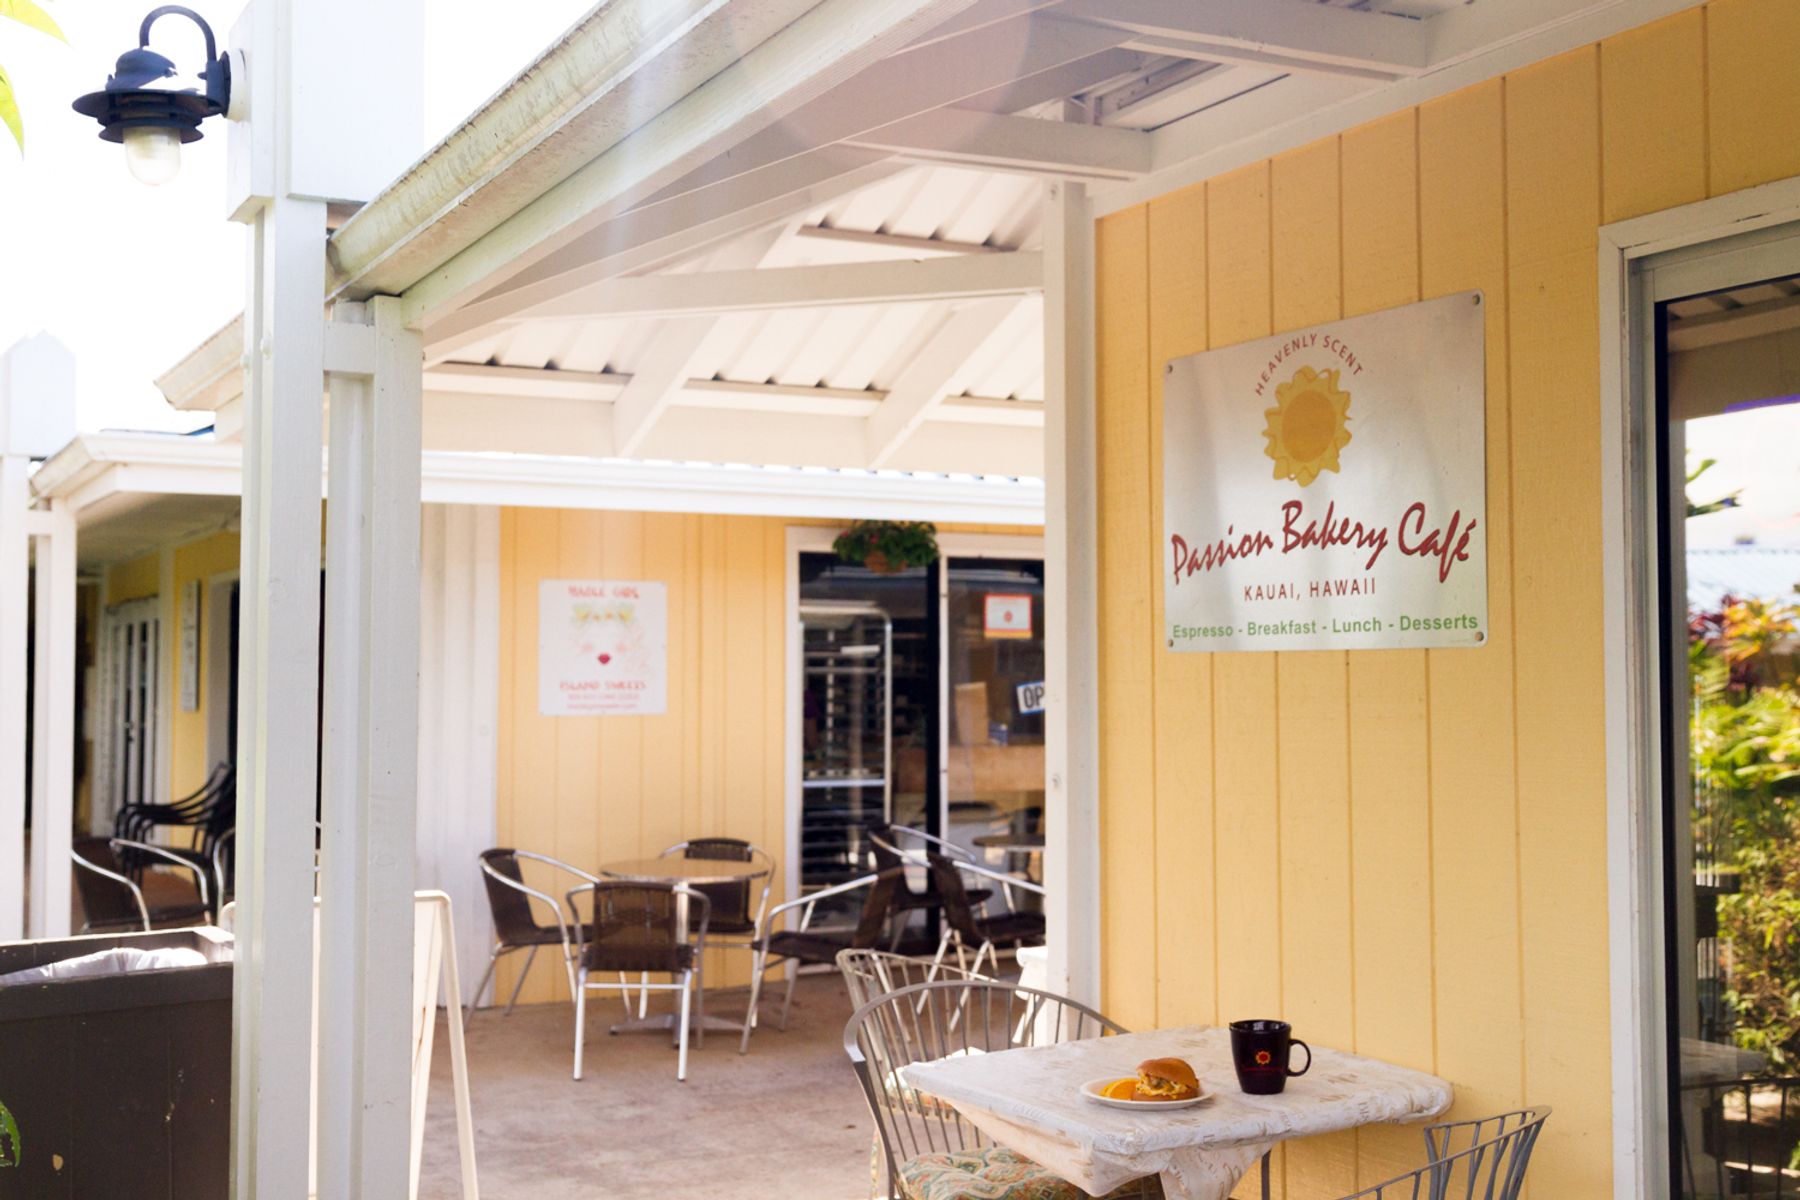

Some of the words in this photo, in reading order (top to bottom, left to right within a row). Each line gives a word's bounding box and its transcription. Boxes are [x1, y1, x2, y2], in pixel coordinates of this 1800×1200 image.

[1255, 333, 1317, 396] HEAVENLY
[1323, 335, 1363, 376] SCENT
[1171, 524, 1274, 585] Passion
[1282, 500, 1388, 571] Bakery
[1398, 502, 1477, 584] Café
[1244, 583, 1301, 601] KAUAI,
[1309, 577, 1376, 598] HAWAII
[1172, 624, 1234, 641] Espresso
[1247, 619, 1317, 636] Breakfast
[1332, 616, 1382, 633] Lunch
[1400, 613, 1478, 631] Desserts
